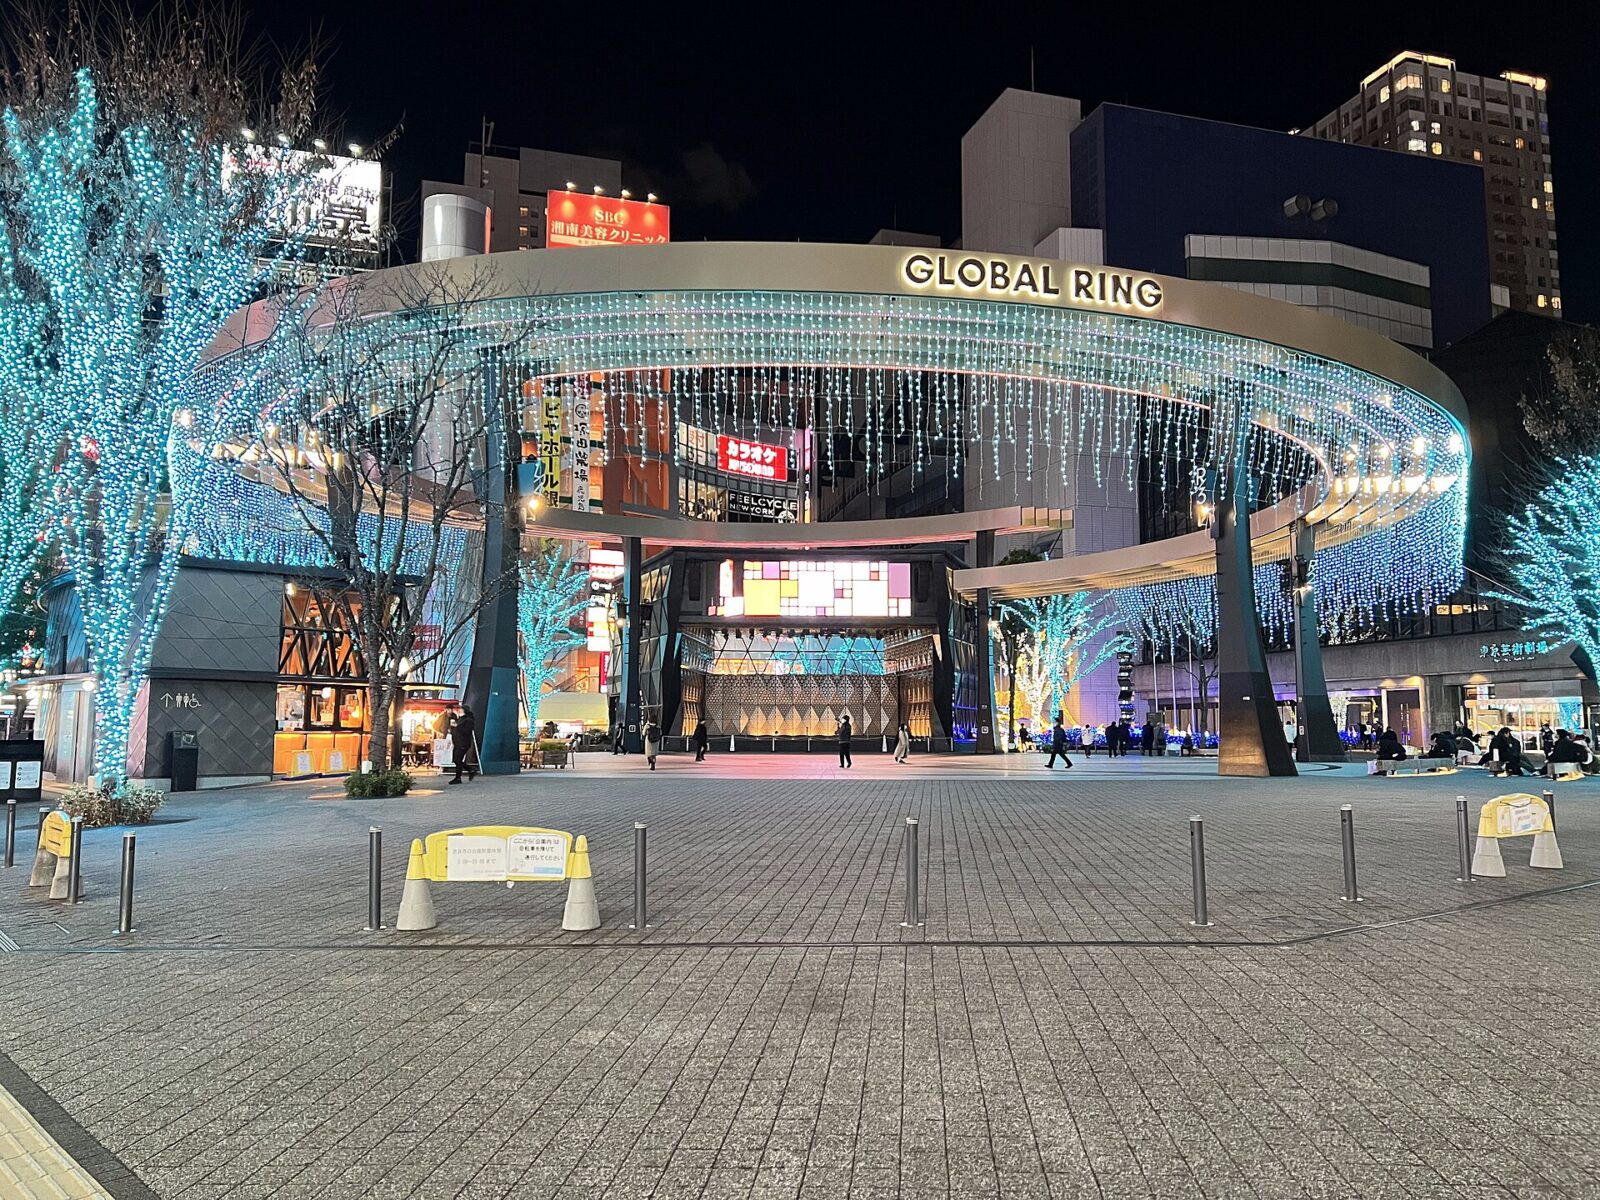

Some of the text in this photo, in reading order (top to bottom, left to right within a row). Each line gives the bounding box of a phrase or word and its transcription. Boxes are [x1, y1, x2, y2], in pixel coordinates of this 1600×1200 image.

[594, 209, 625, 225] SBC
[551, 219, 667, 245] 湘南美容クリニック
[905, 254, 1163, 308] GLOBAL RING
[726, 440, 778, 464] カラオケ
[729, 493, 798, 511] FEELCYCLE
[1479, 640, 1550, 659] 東京芸術劇場
